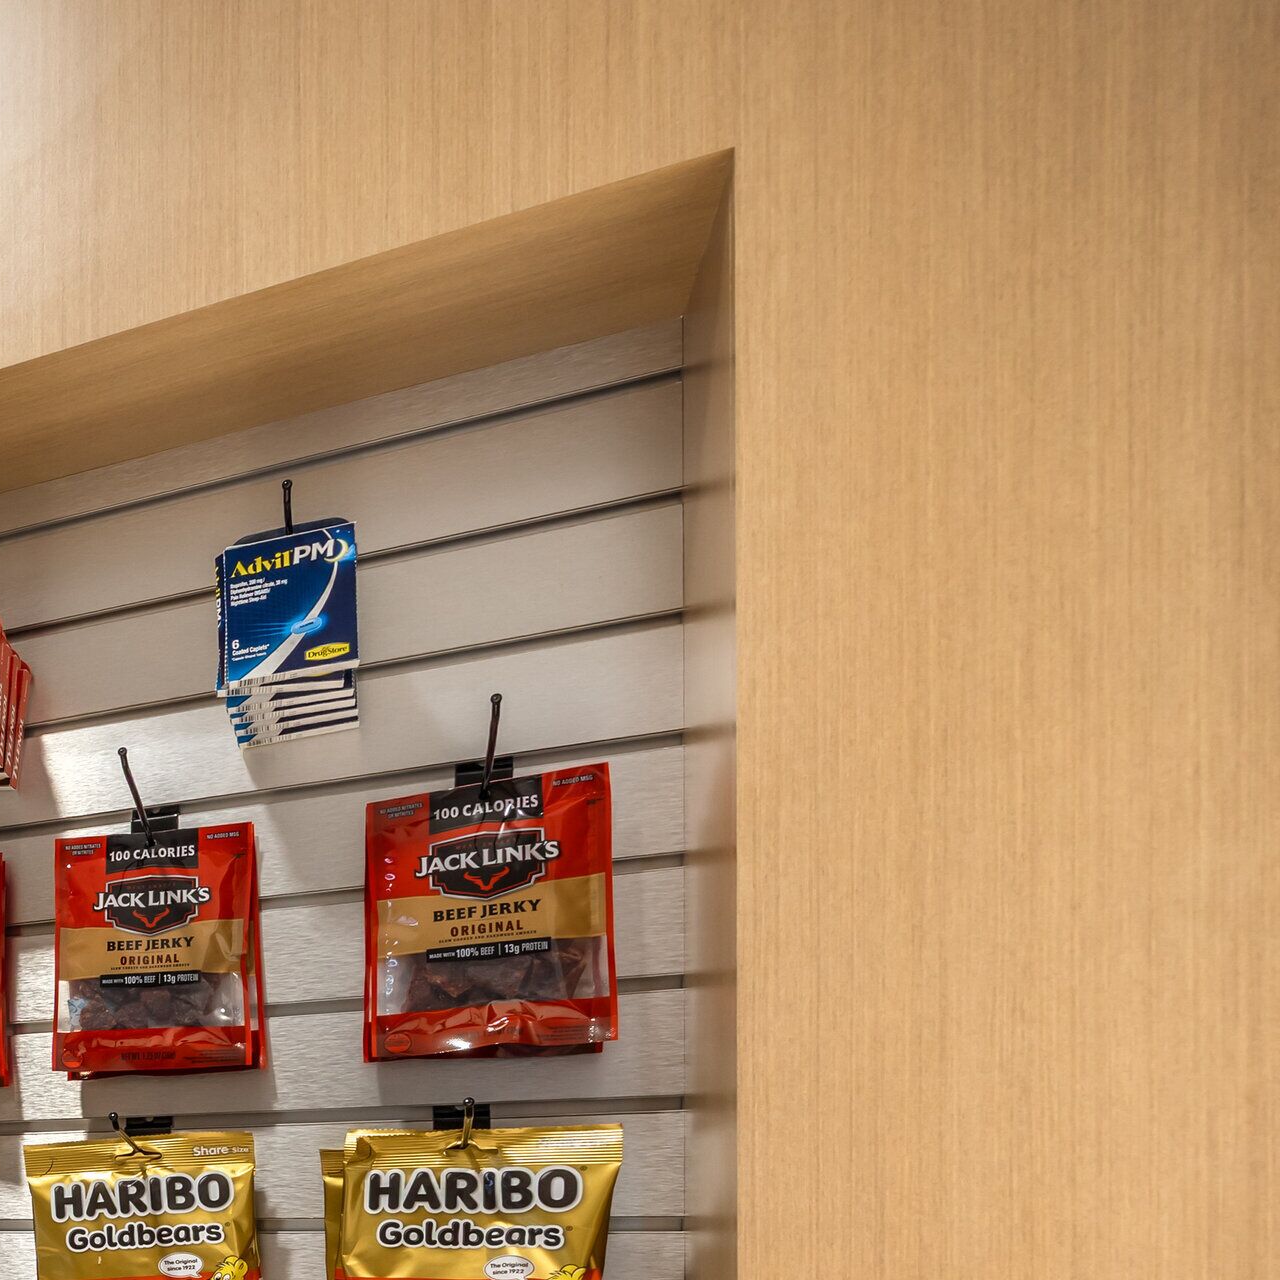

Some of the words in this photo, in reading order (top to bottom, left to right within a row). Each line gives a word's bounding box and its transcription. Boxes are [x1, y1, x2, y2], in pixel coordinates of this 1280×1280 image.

[229, 550, 291, 578] Advil
[293, 539, 334, 565] PM
[232, 639, 239, 649] 6
[434, 806, 459, 821] 100
[463, 795, 539, 816] CALORIES
[109, 851, 130, 862] 100
[133, 845, 195, 860] CALORIES
[416, 853, 480, 878] JACK
[482, 840, 561, 869] LINK'S
[94, 893, 146, 911] JACK
[148, 887, 210, 905] LINK'S
[433, 907, 477, 923] BEEF
[480, 899, 541, 918] JERKY
[451, 920, 524, 937] ORIGINAL
[107, 941, 142, 952] BEEF
[145, 936, 195, 951] JERKY
[456, 947, 479, 958] 100%
[481, 946, 495, 955] BEEF
[505, 944, 520, 954] 13g
[522, 941, 548, 951] PROTEIN
[120, 953, 180, 966] ORIGINAL
[124, 976, 143, 984] 100%
[163, 974, 175, 983] 13g
[193, 1146, 229, 1156] Share
[52, 1173, 232, 1221] HARIBO
[366, 1168, 579, 1212] HARIBO
[67, 1224, 222, 1250] Goldbears
[378, 1219, 563, 1248] Goldbears
[503, 1262, 529, 1270] Original
